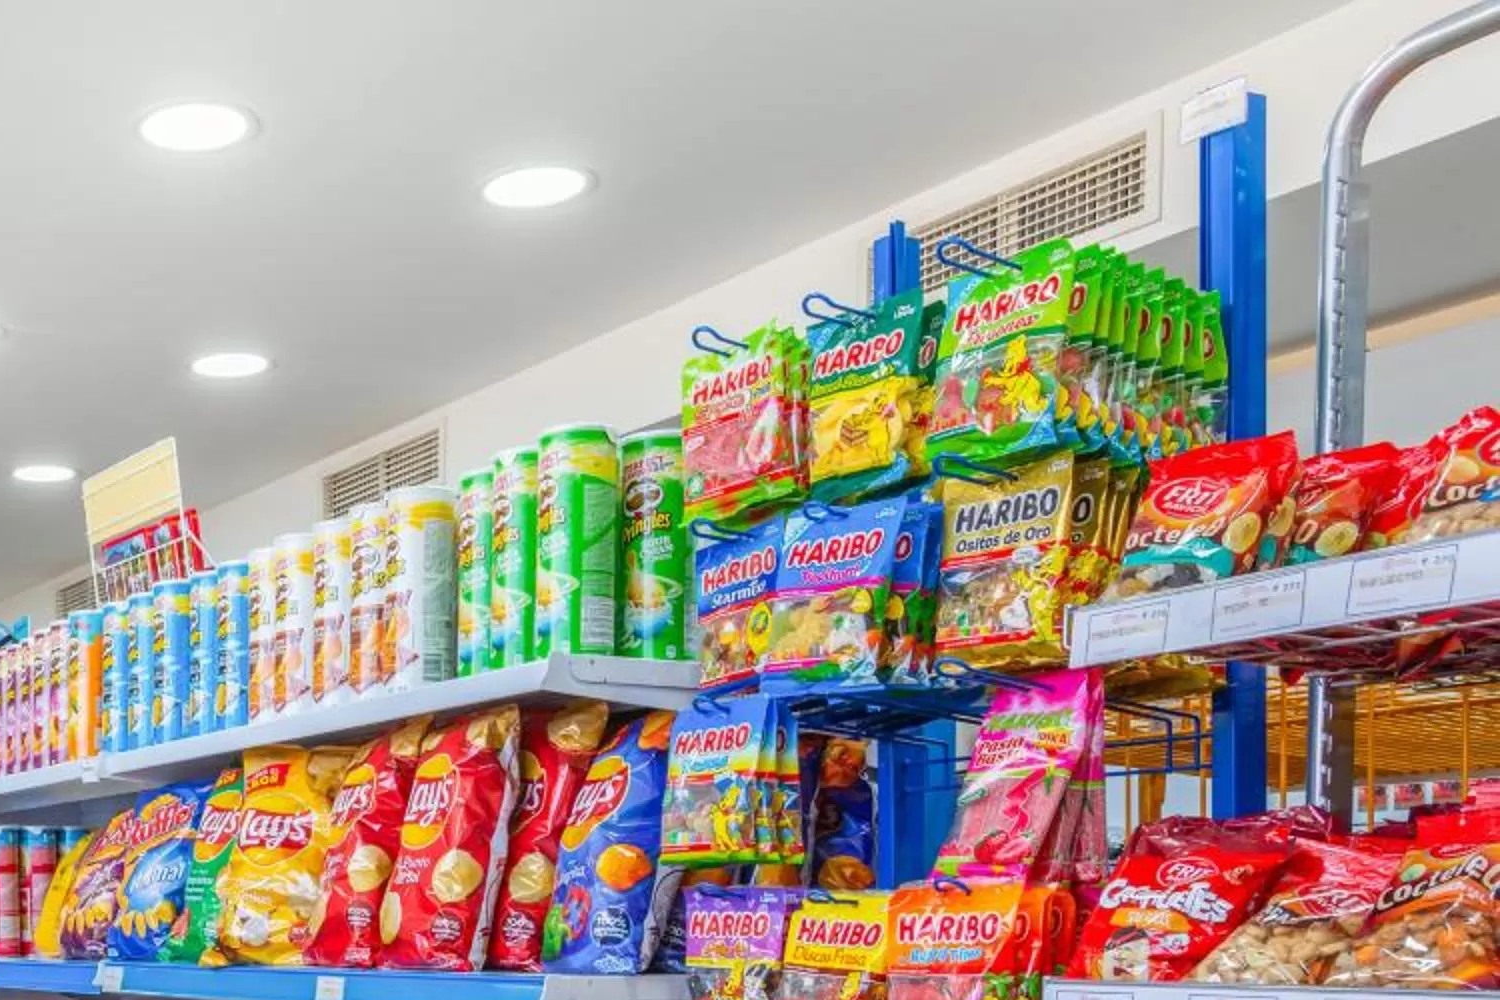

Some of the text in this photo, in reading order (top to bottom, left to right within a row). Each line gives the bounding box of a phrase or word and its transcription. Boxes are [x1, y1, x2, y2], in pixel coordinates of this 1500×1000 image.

[954, 273, 1060, 333] HARIBO
[813, 329, 904, 378] HARIBO
[692, 355, 773, 405] HARIBO
[955, 487, 1061, 534] HARIBO
[786, 528, 885, 568] HARIBO
[956, 526, 1051, 553] Ositos de Oro
[702, 545, 777, 596] HARIBO
[675, 722, 752, 755] HARIBO
[239, 808, 317, 849] Lay's
[690, 911, 770, 939] HARIBO
[798, 918, 883, 947] HARIBO
[898, 911, 1000, 944] HARIBO
